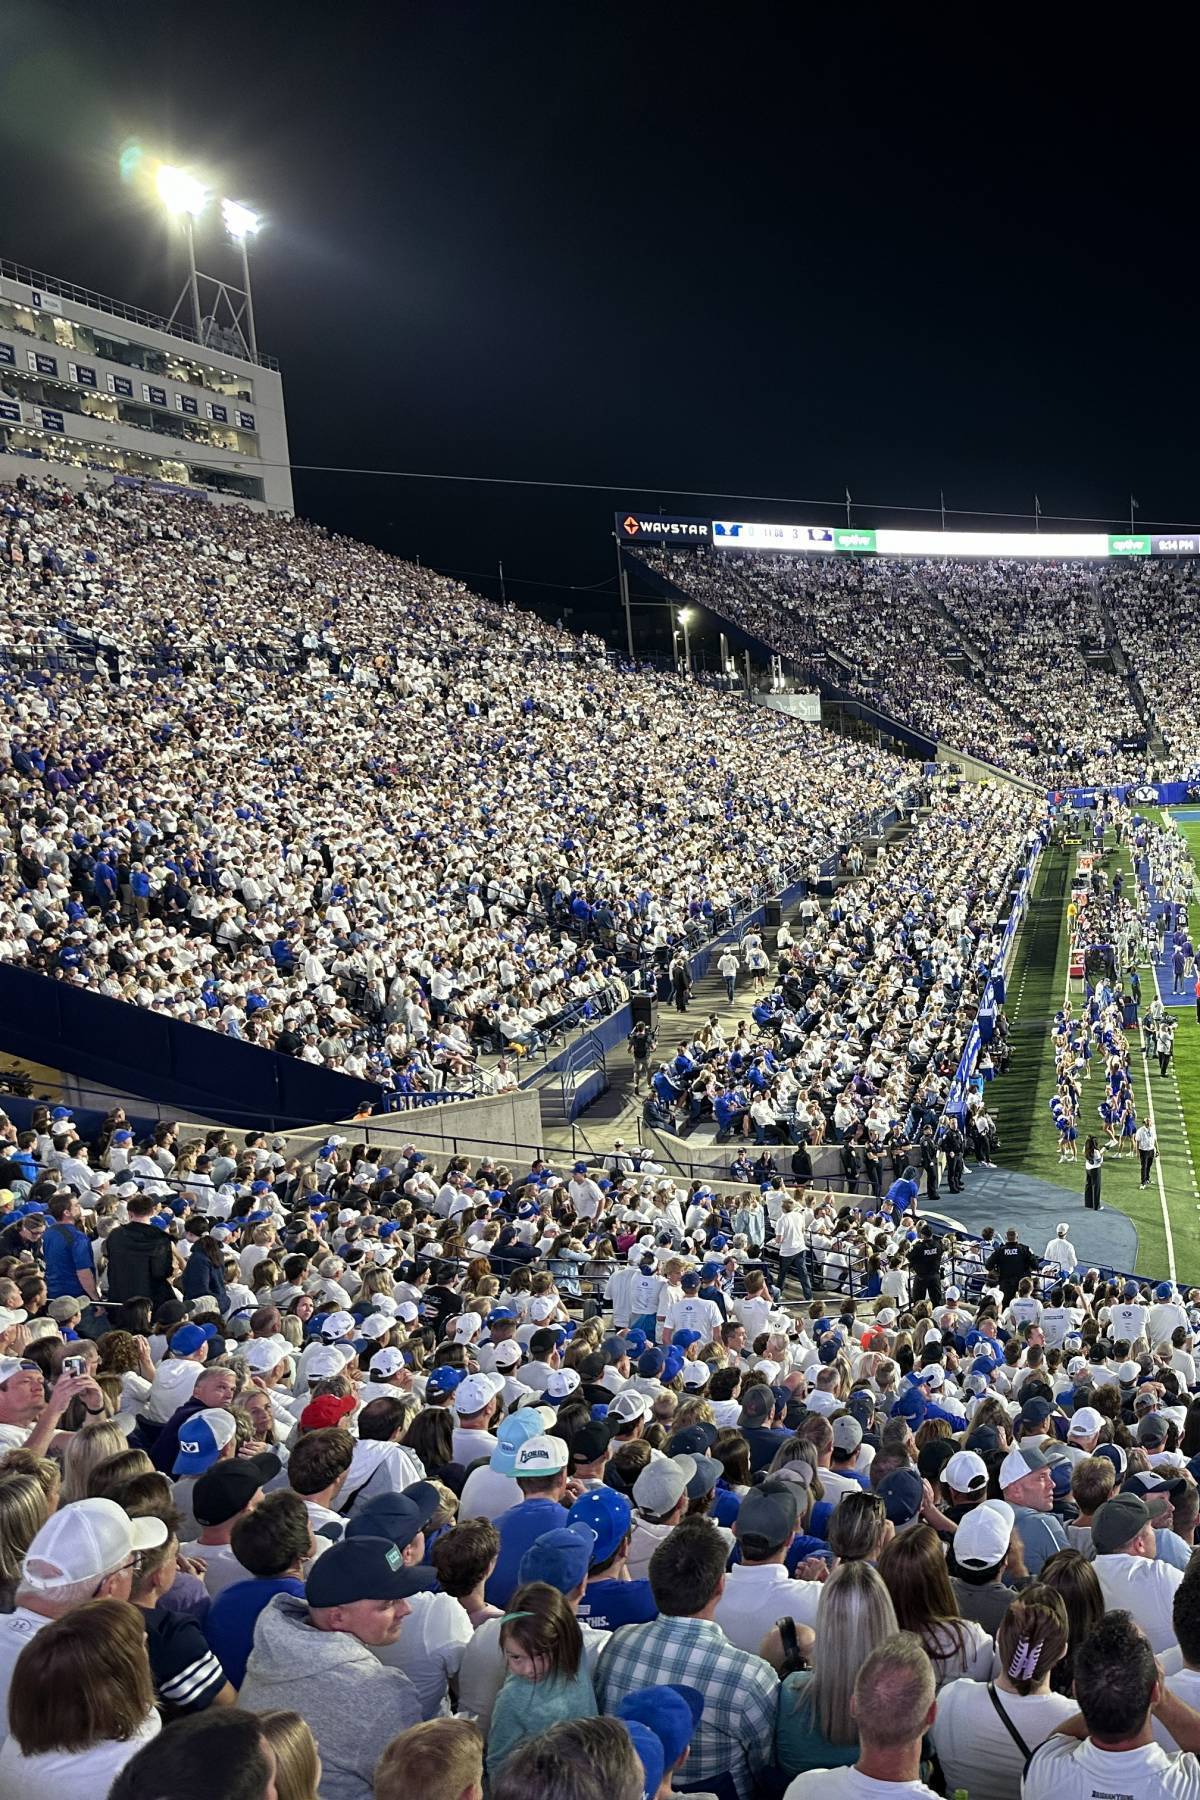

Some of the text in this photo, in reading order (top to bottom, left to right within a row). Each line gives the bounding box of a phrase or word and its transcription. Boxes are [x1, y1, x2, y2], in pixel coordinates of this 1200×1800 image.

[639, 521, 708, 536] WAYSTAR
[924, 1248, 938, 1256] POLICE
[520, 1450, 550, 1464] FLORIDA
